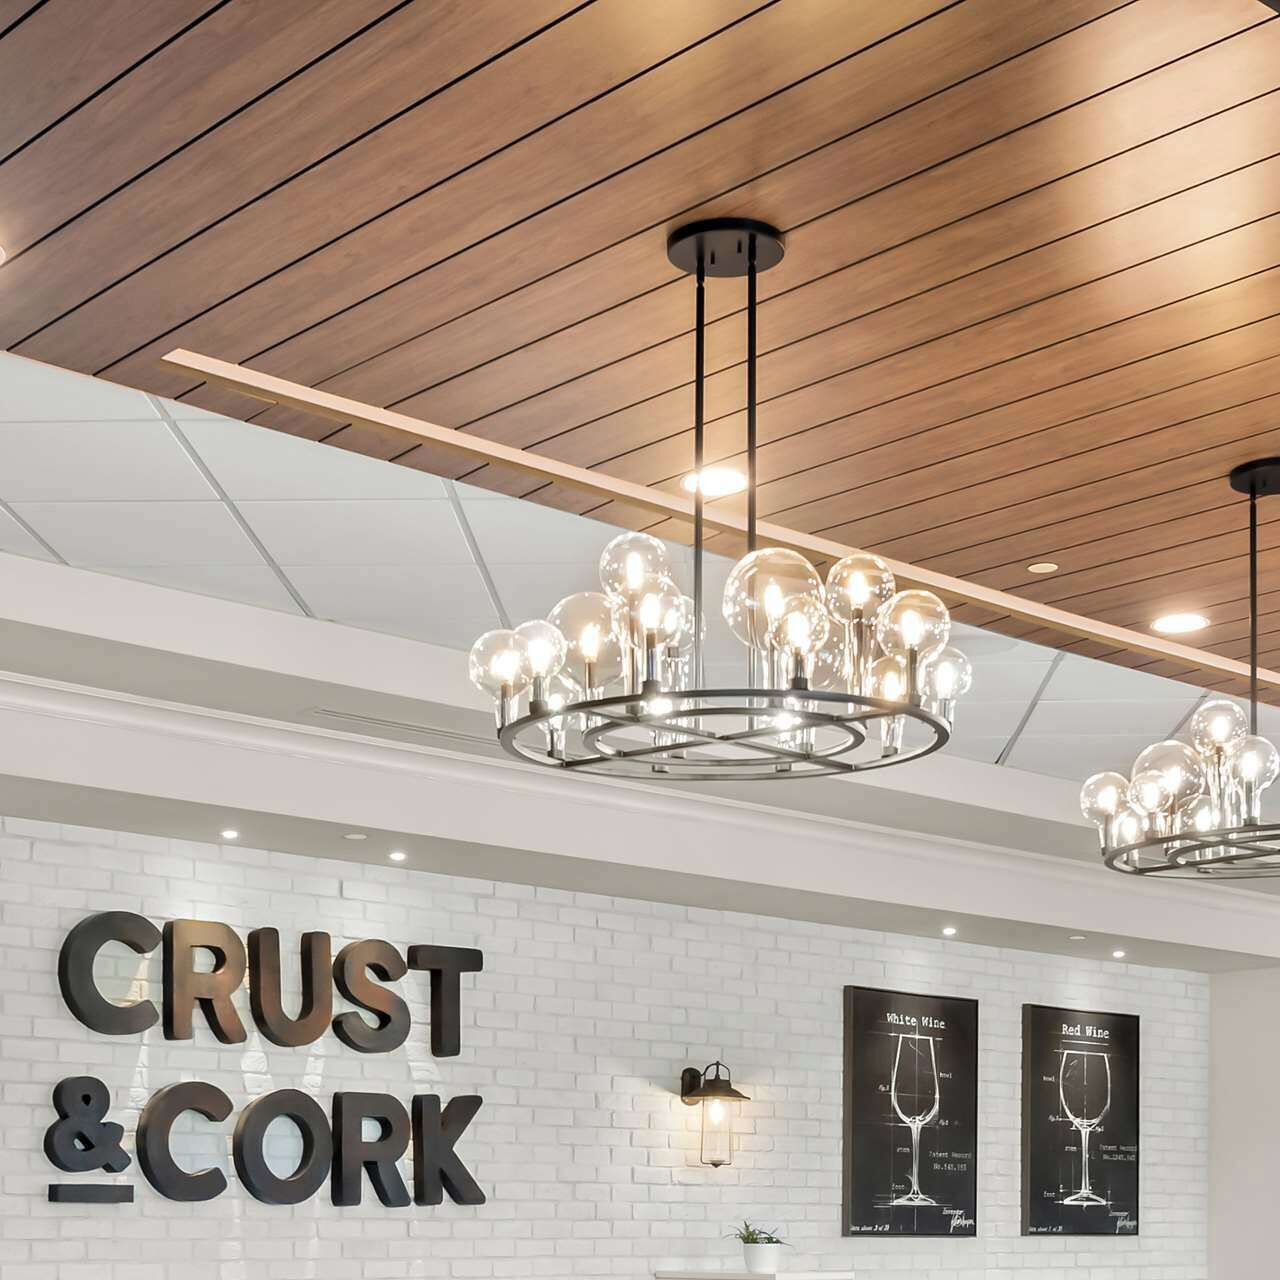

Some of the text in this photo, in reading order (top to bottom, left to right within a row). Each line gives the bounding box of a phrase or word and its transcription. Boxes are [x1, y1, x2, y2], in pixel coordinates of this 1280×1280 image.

[57, 910, 484, 1058] CRUST
[886, 1012, 946, 1029] White Wine
[1062, 1024, 1110, 1039] Red Wine
